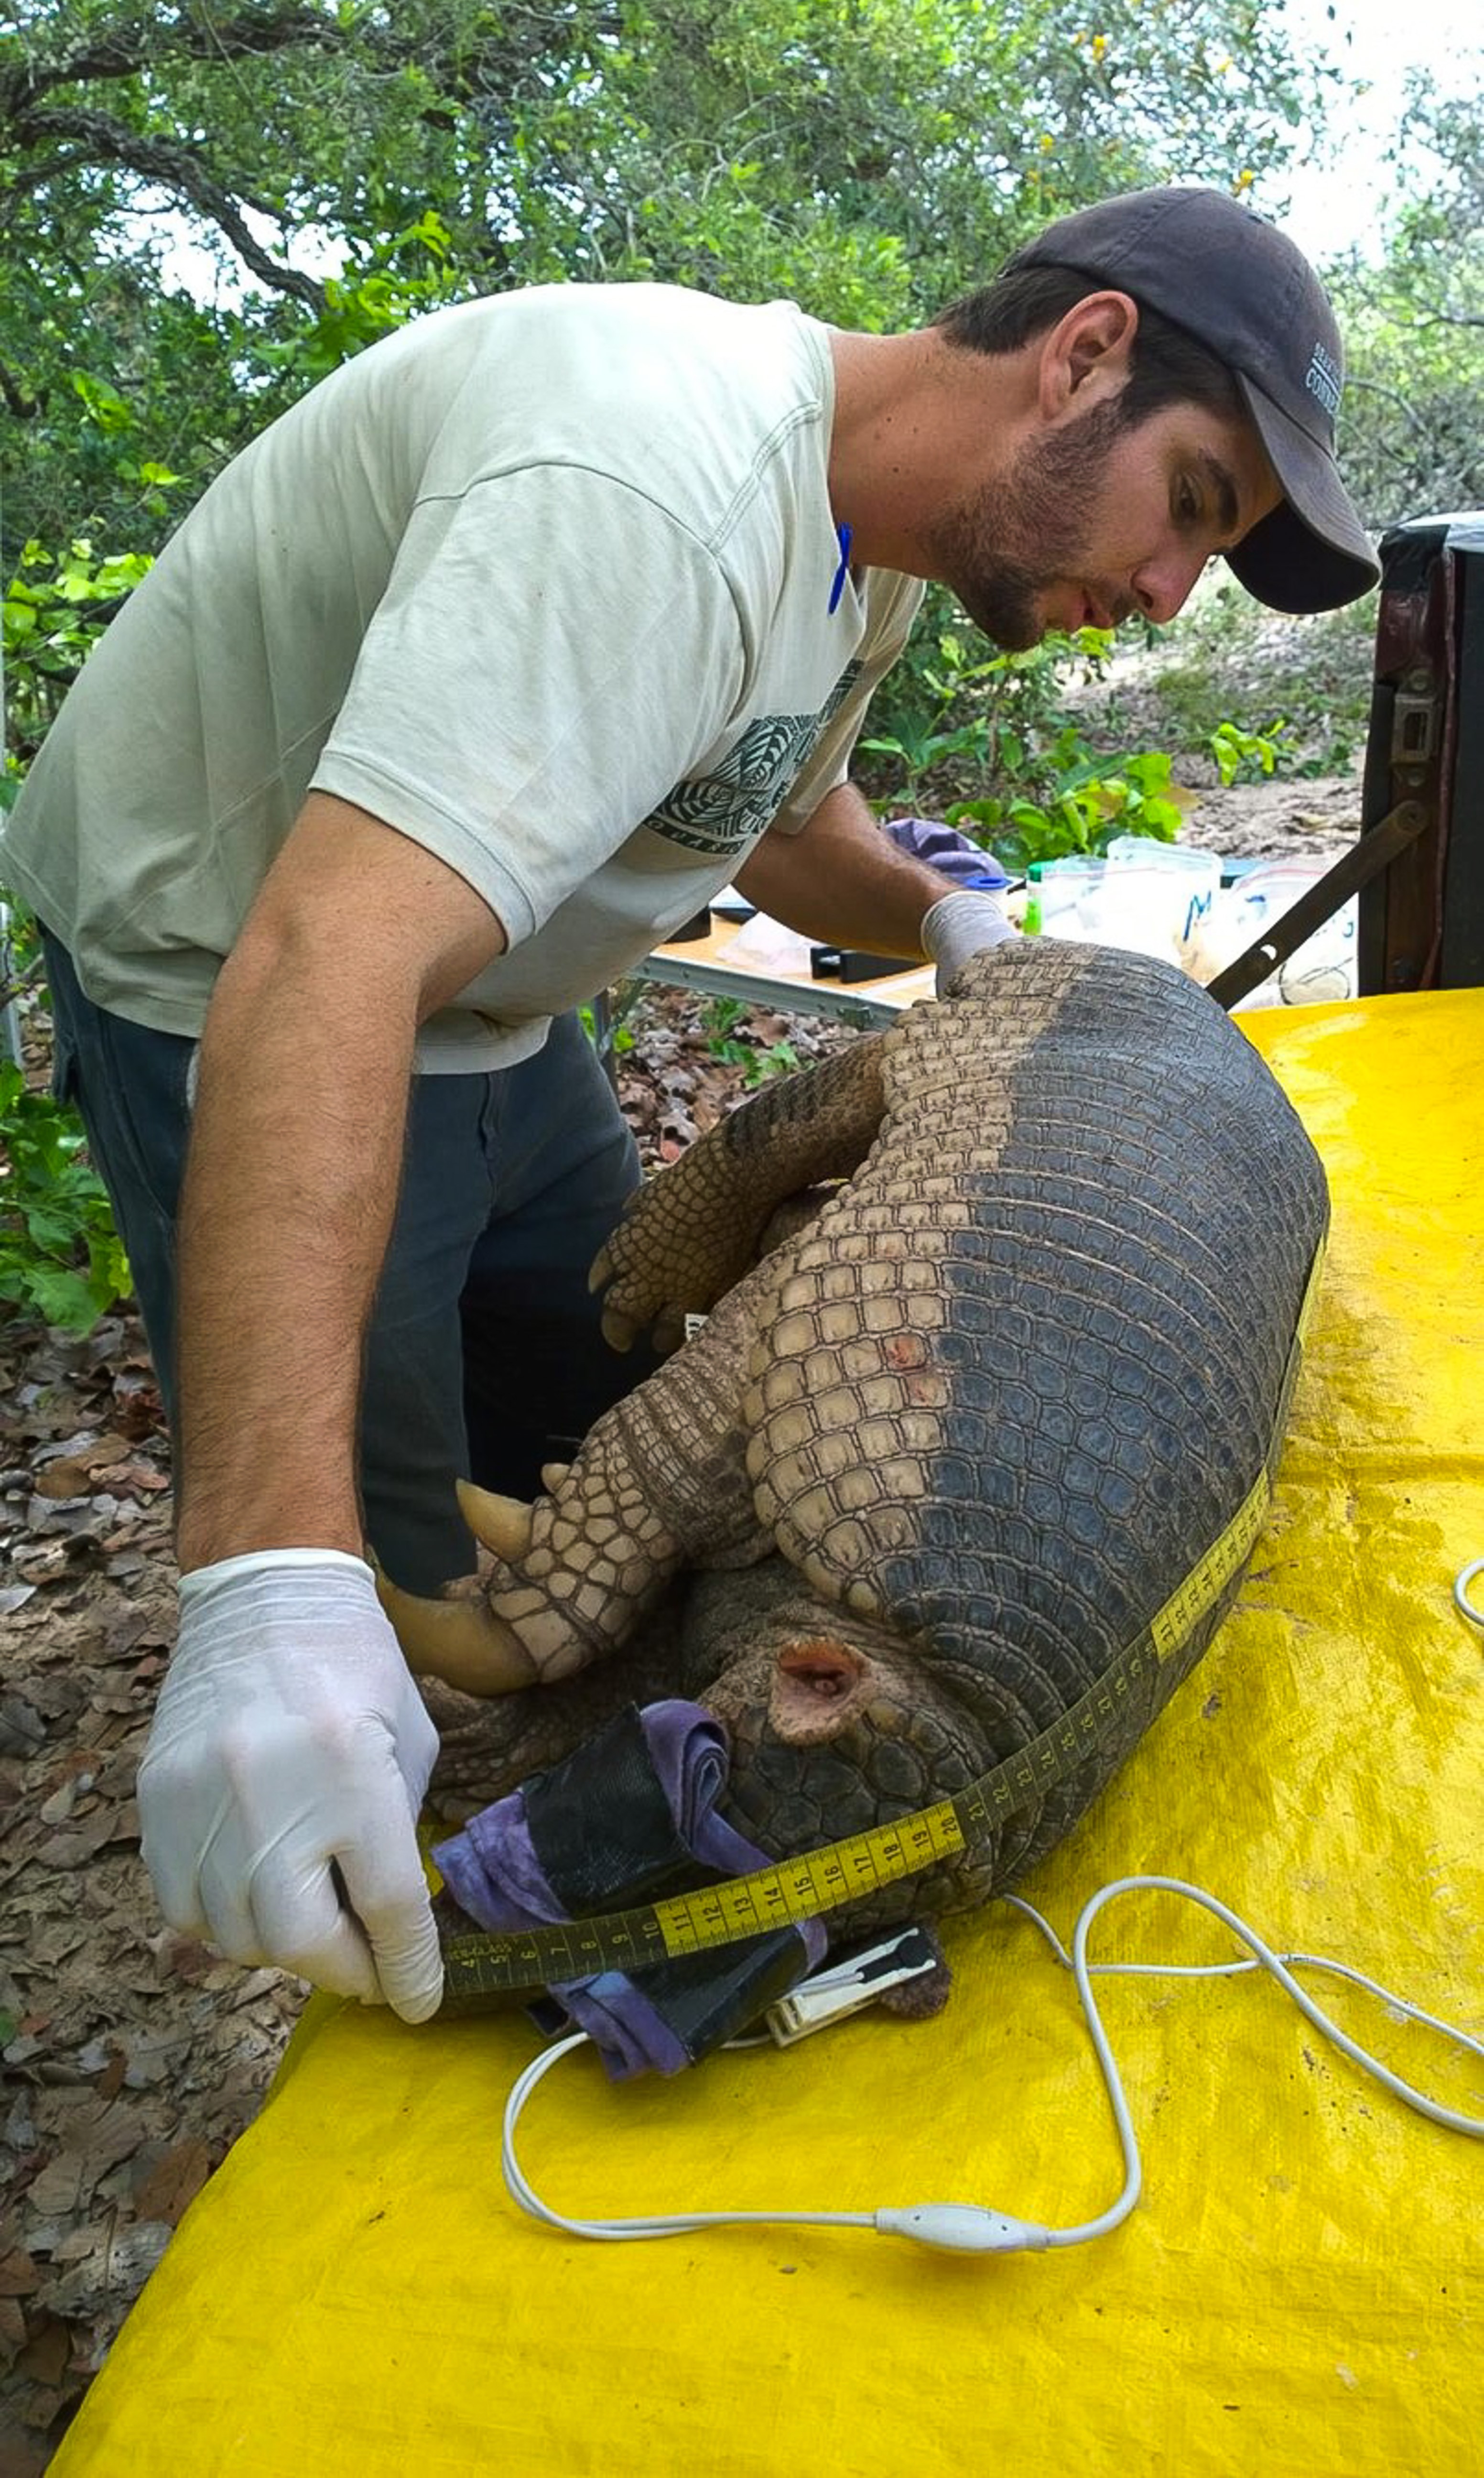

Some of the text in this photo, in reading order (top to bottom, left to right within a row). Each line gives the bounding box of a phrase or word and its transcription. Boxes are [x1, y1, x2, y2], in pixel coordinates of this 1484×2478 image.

[461, 1958, 475, 1968] 4
[490, 1956, 507, 1964] 5
[520, 1951, 536, 1959] 6
[581, 1941, 596, 1950] 8
[612, 1933, 629, 1944] 9
[642, 1922, 660, 1939] 10
[672, 1913, 691, 1931] 11
[703, 1905, 721, 1923] 12
[733, 1897, 752, 1915] 13
[764, 1887, 784, 1906] 14
[794, 1877, 813, 1896] 15
[824, 1865, 842, 1885] 16
[854, 1856, 872, 1873] 17
[883, 1844, 901, 1861] 18
[912, 1830, 929, 1848] 19
[941, 1817, 958, 1835] 20
[968, 1802, 985, 1821] 21
[992, 1783, 1009, 1804] 22
[1017, 1769, 1033, 1787] 23
[1040, 1750, 1055, 1770] 24
[1061, 1731, 1075, 1752] 25
[1098, 1695, 1112, 1715] 27
